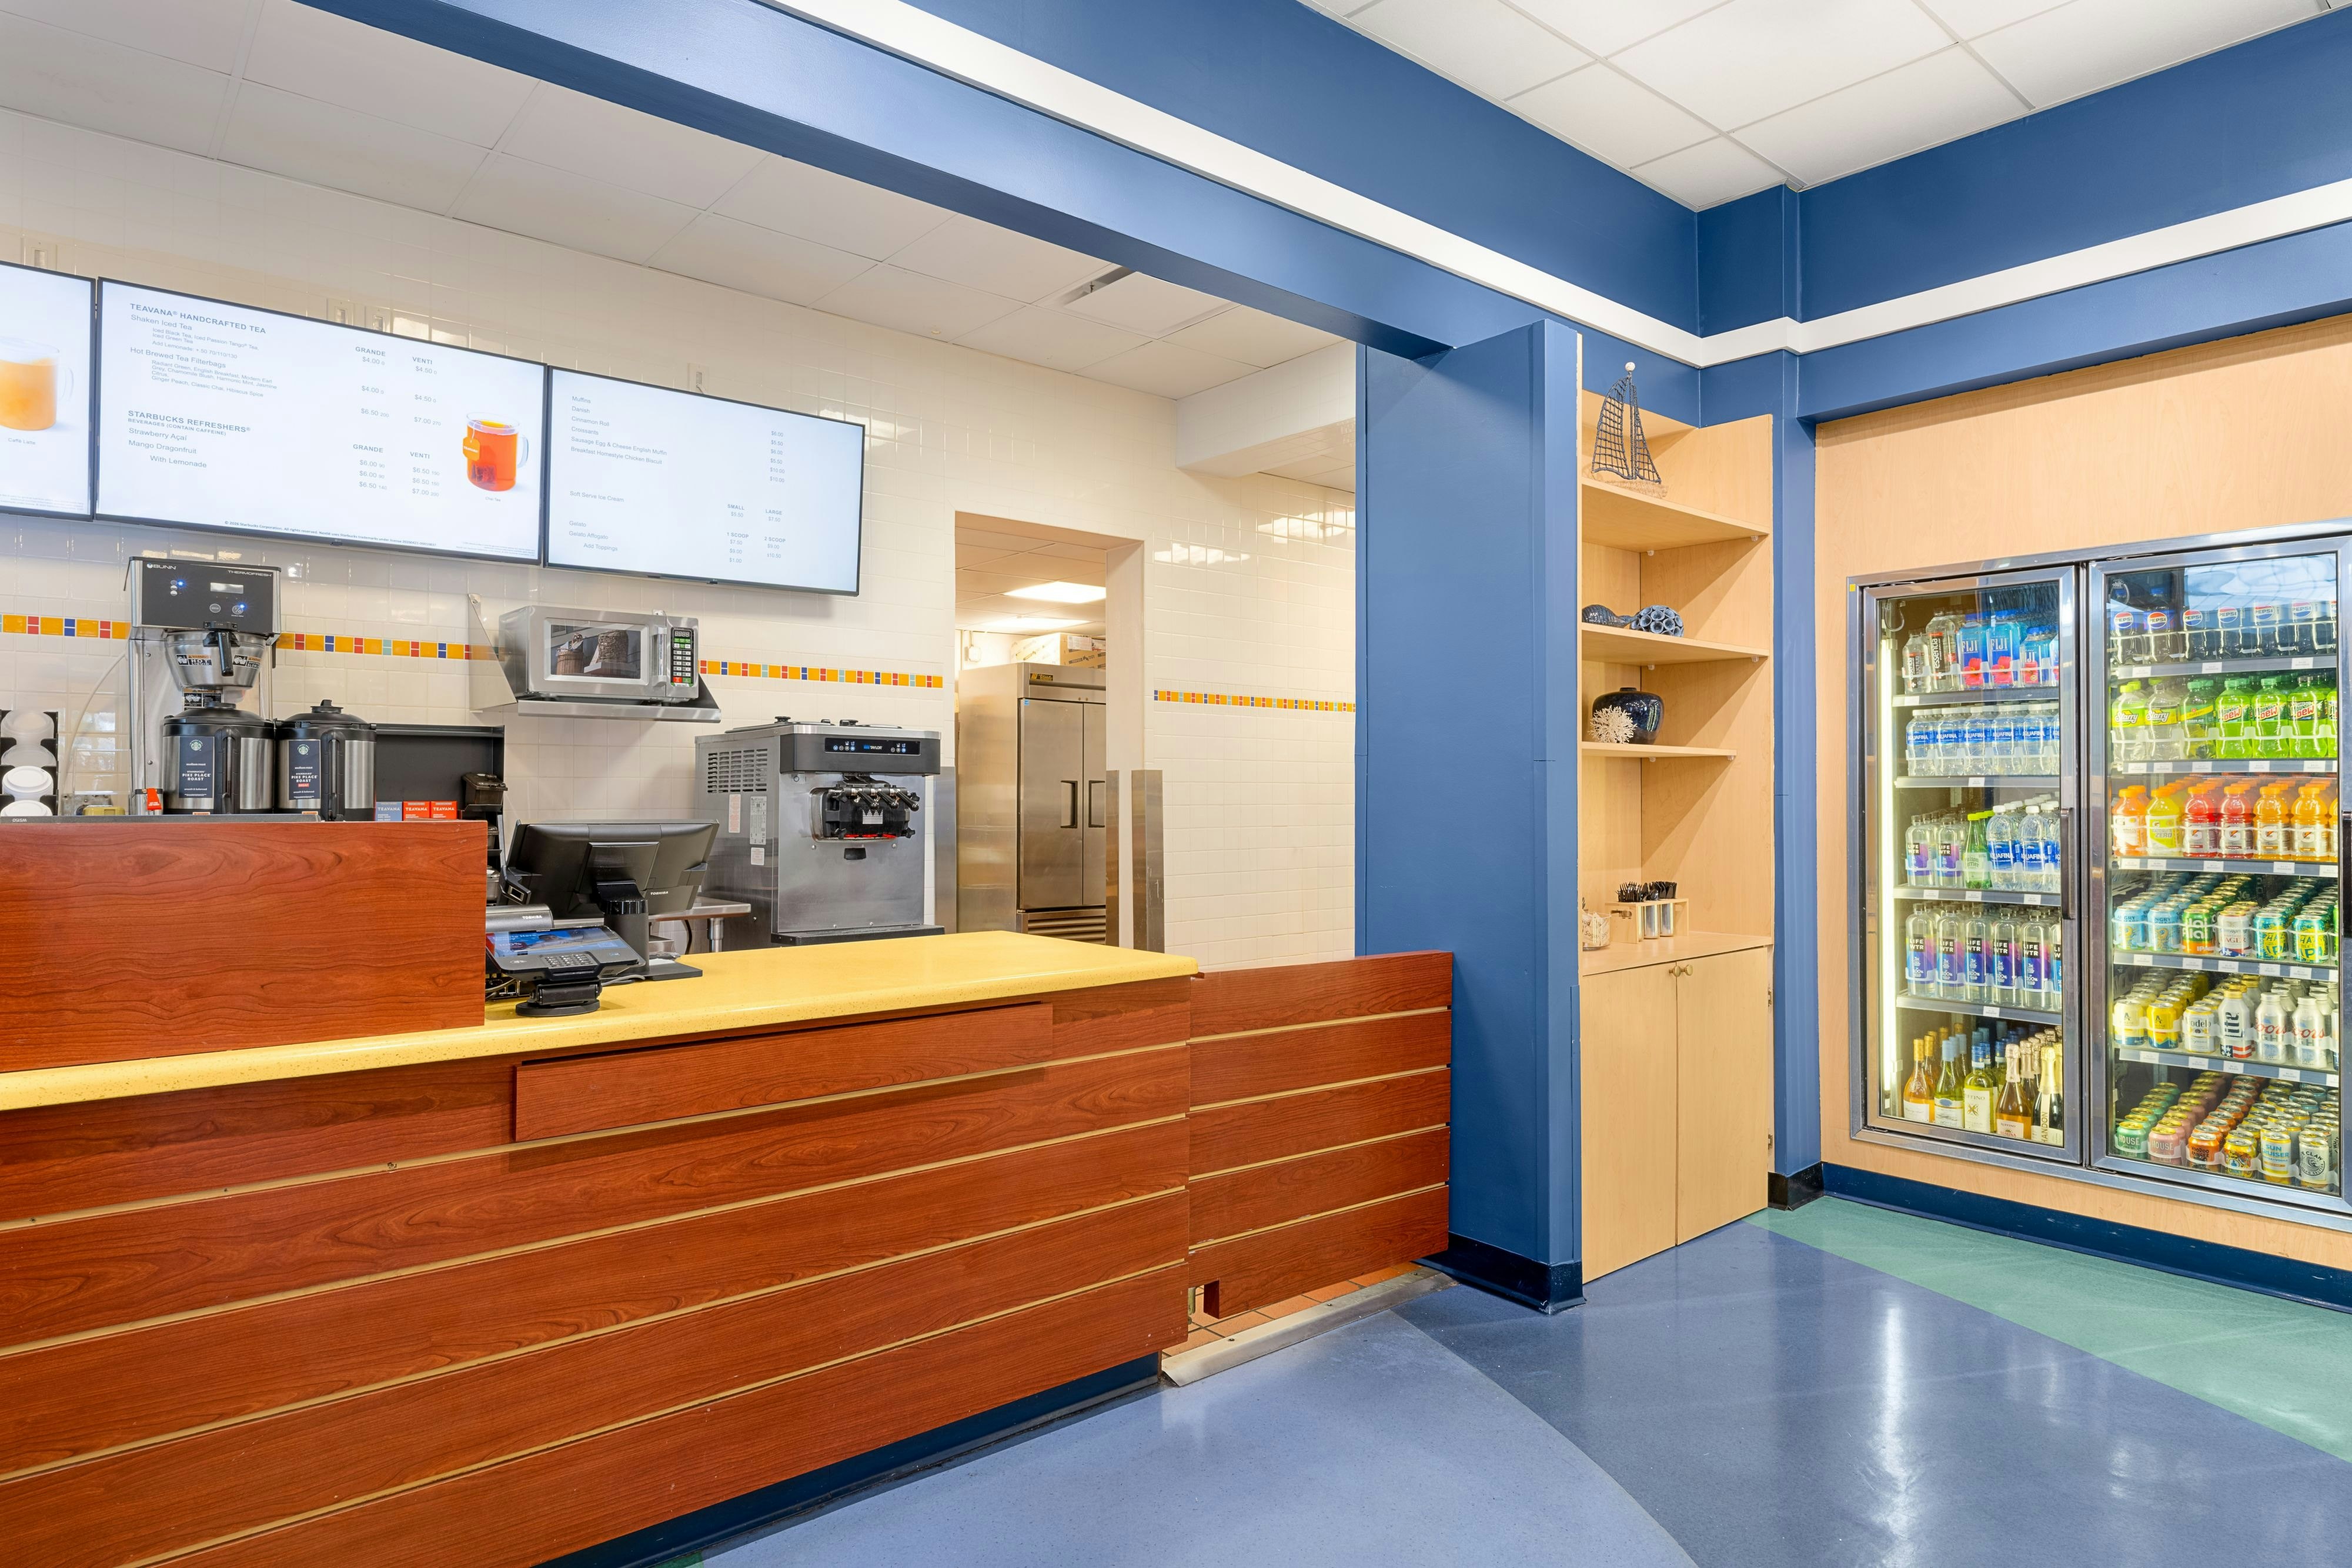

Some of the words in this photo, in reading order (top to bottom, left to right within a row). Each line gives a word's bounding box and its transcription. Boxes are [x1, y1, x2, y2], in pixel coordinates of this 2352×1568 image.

[131, 314, 159, 325] Shaken
[161, 320, 177, 328] Iced
[180, 313, 246, 330] HANDCRAFTED
[249, 326, 266, 334] TEA
[165, 342, 195, 352] Lemonade:
[355, 346, 386, 357] GRANDE
[145, 350, 173, 359] Brewed
[191, 357, 226, 369] Filterbags
[362, 356, 380, 365] $4.00
[412, 356, 433, 365] VENTI
[167, 367, 198, 377] Chamomile
[193, 366, 213, 375] English
[415, 366, 433, 374] $4.50
[361, 385, 379, 394] $4.00
[414, 394, 432, 403] $4.50
[572, 396, 591, 404] Muffins
[571, 406, 590, 414] Danish
[128, 410, 184, 423] STARBUCKS
[414, 416, 431, 424] $7.00
[571, 416, 599, 426] Cinnamon
[128, 418, 165, 427] BEVERAGES
[166, 423, 194, 432] (CONTAIN
[196, 427, 226, 436] CAFFEINE)
[571, 426, 599, 436] Croissants
[129, 427, 169, 440] Strawberry
[128, 440, 154, 449] Mango
[156, 443, 197, 454] Dragonfruit
[353, 443, 383, 453] GRANDE
[570, 436, 594, 445] Sausage
[633, 446, 651, 454] English
[409, 451, 430, 459] VENTI
[570, 446, 596, 455] Breakfast
[596, 450, 623, 459] Homestyle
[150, 455, 166, 463] With
[169, 458, 207, 468] Lemonade
[594, 544, 618, 552] Toppings
[1961, 640, 1978, 653] FIJI
[1990, 637, 2008, 651] FIJI
[1932, 638, 1940, 669] essentia
[2114, 711, 2139, 723] Starry
[2146, 708, 2170, 722] Starry
[2119, 1135, 2140, 1146] HOUSE
[2151, 1141, 2174, 1151] HOUSE
[2304, 1151, 2323, 1161] CLAW
